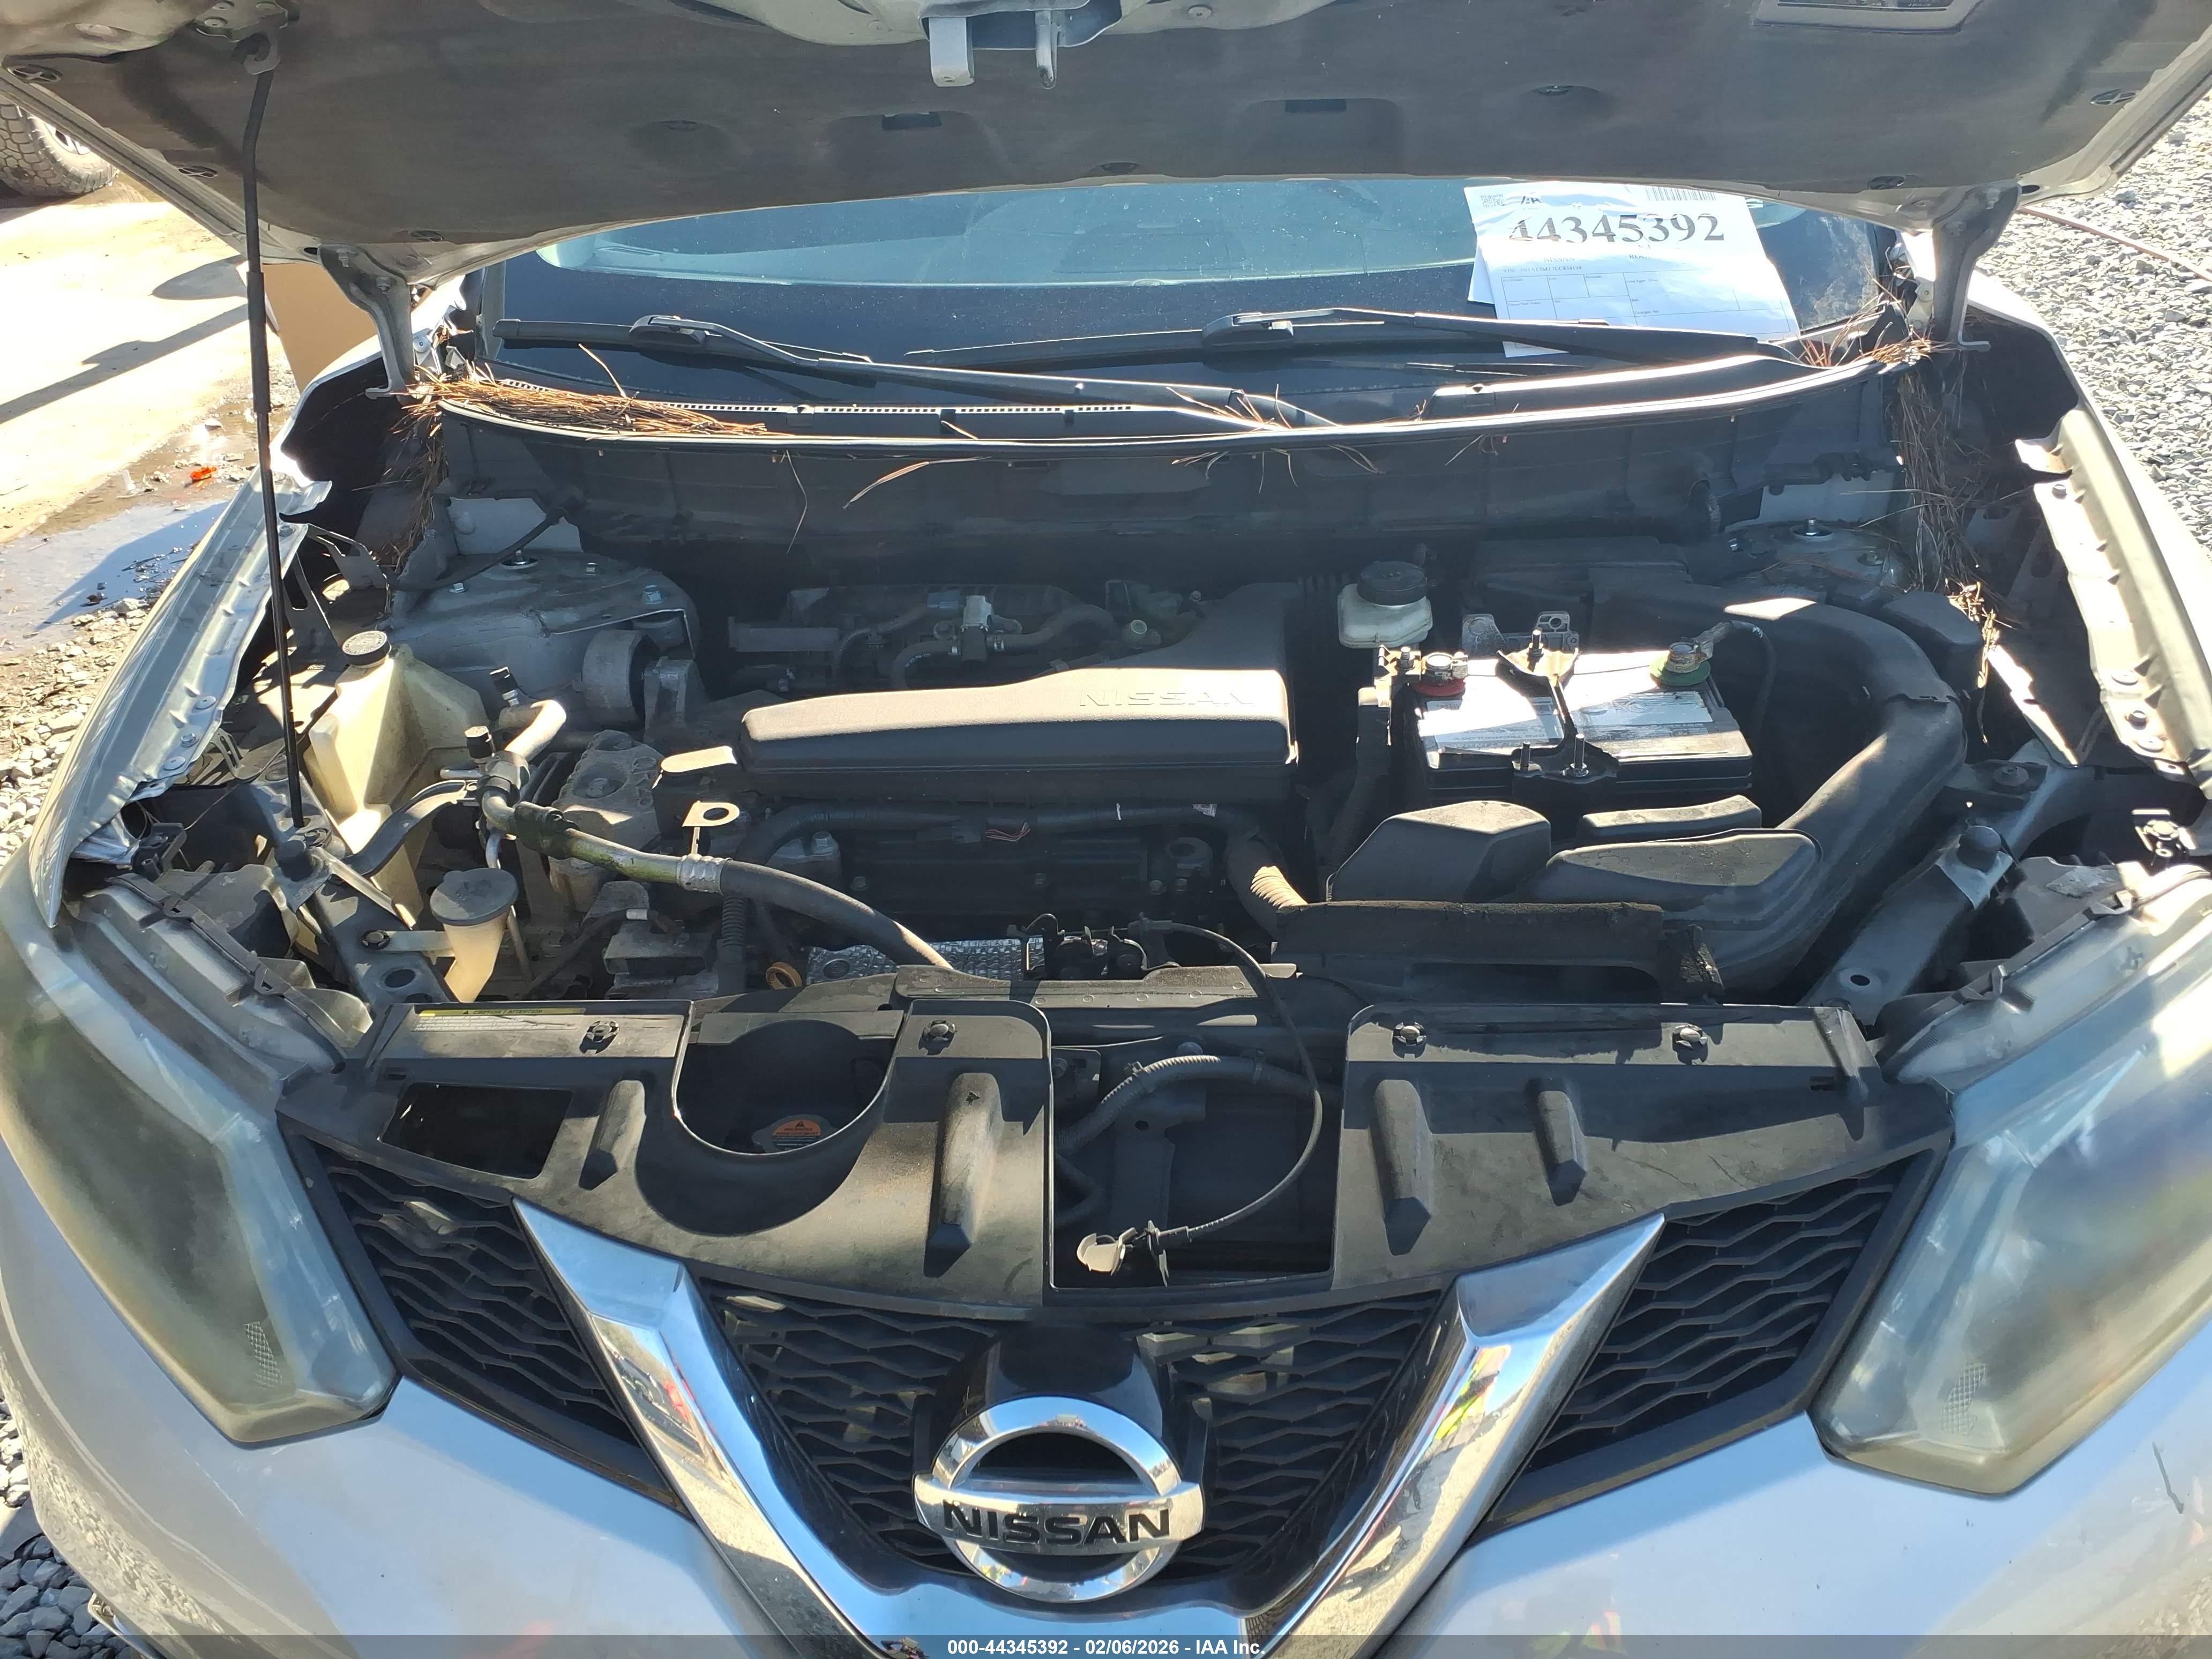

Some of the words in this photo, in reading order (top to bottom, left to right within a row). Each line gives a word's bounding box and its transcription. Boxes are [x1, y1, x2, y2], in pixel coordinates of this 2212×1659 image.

[1508, 214, 1724, 243] 44345392
[1080, 692, 1253, 706] NISSAN
[942, 1499, 1171, 1544] NISSAN
